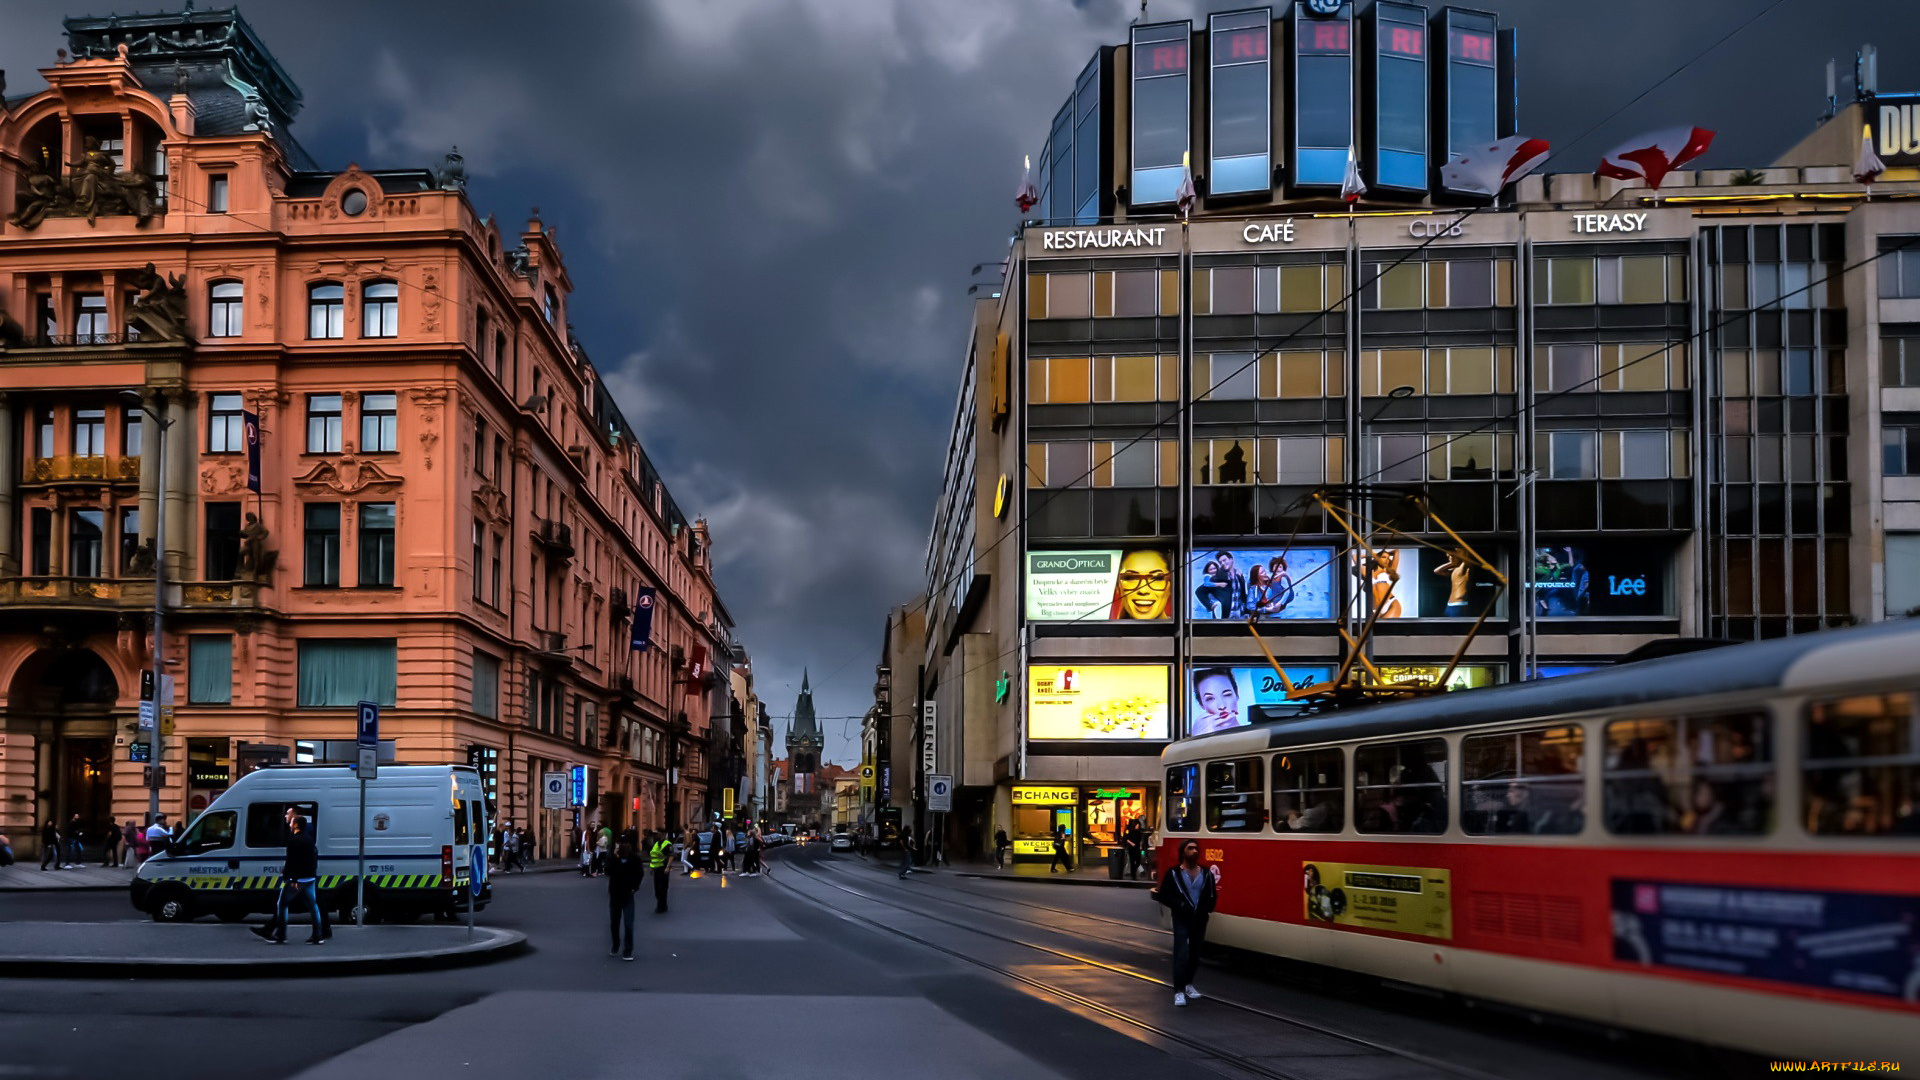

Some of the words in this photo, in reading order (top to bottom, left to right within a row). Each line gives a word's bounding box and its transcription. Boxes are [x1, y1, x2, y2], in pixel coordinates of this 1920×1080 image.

[1243, 218, 1294, 243] CAFÉ
[1409, 219, 1463, 238] CLUB
[1573, 212, 1648, 234] TERASY
[1043, 228, 1166, 250] RESTAURANT
[1608, 575, 1646, 595] Lee
[363, 707, 375, 732] P
[1024, 791, 1078, 800] CHANGE
[380, 864, 395, 872] 156
